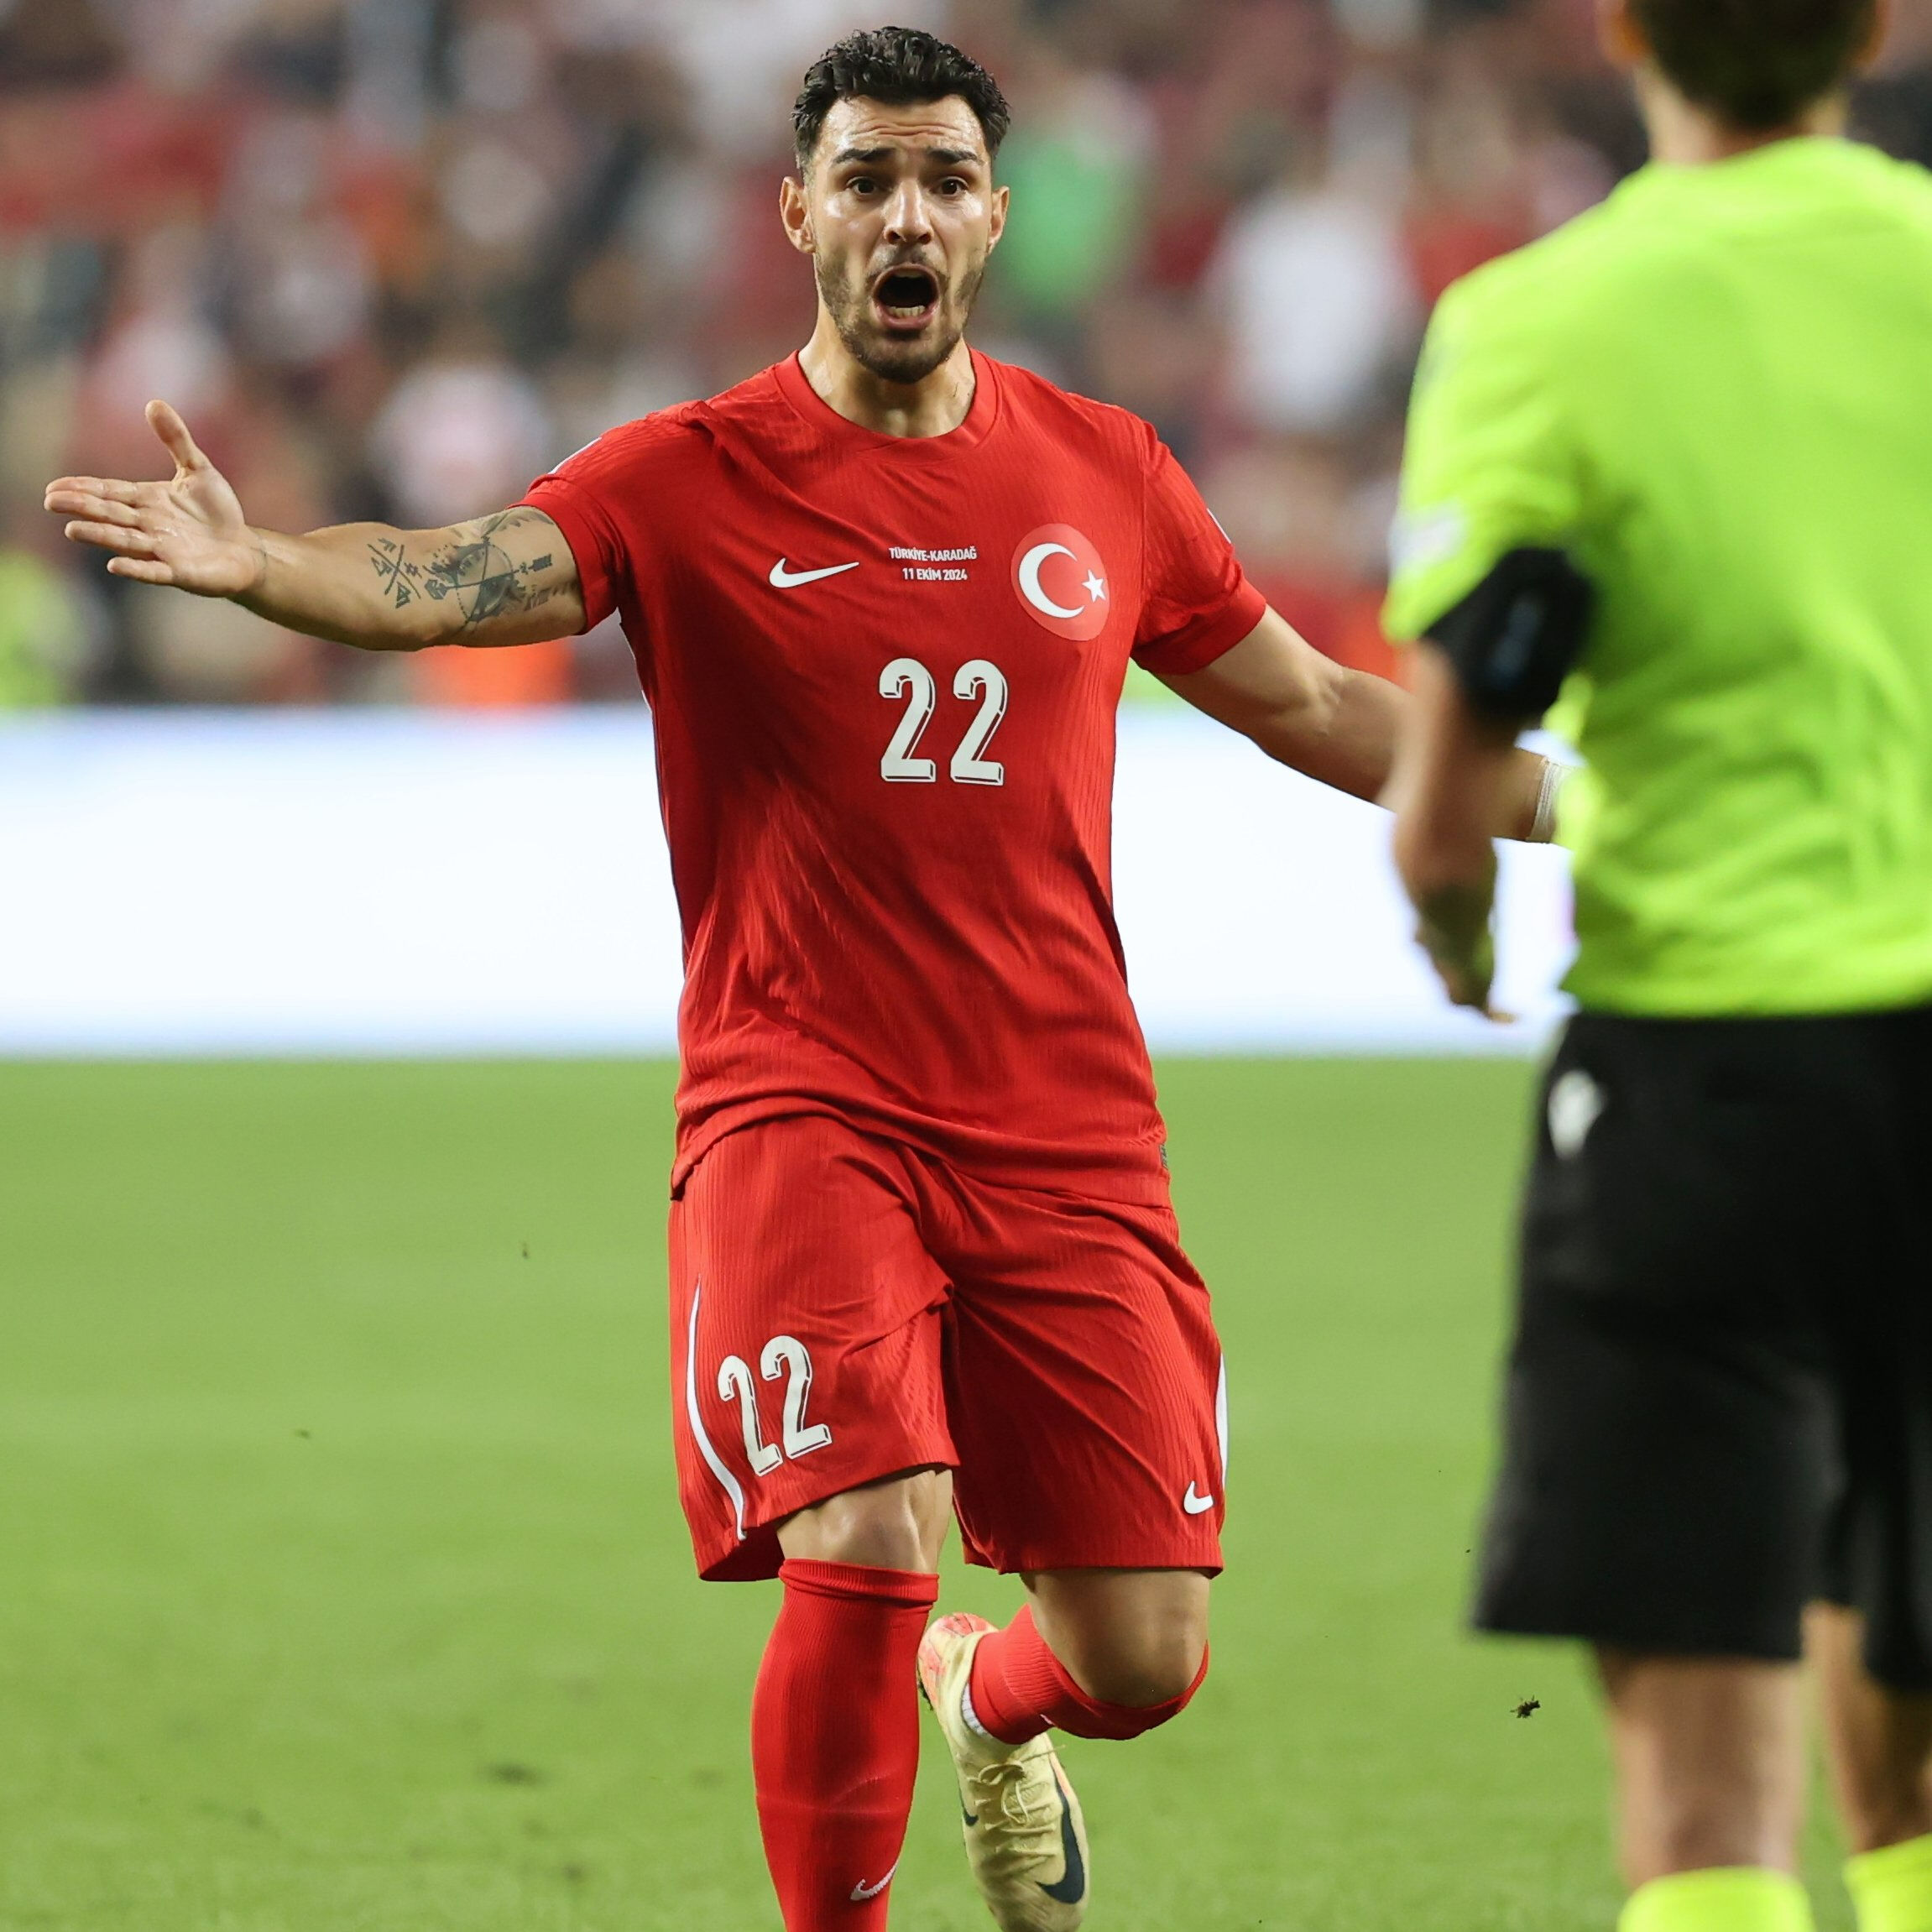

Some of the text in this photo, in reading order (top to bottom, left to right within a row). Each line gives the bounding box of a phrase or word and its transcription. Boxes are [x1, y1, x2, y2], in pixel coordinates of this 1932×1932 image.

[888, 546, 978, 561] TÜRKİYE-KARADAĞ
[902, 567, 969, 581] 11 EKİM 2024
[879, 657, 1008, 786] 22
[718, 1334, 833, 1477] 22
